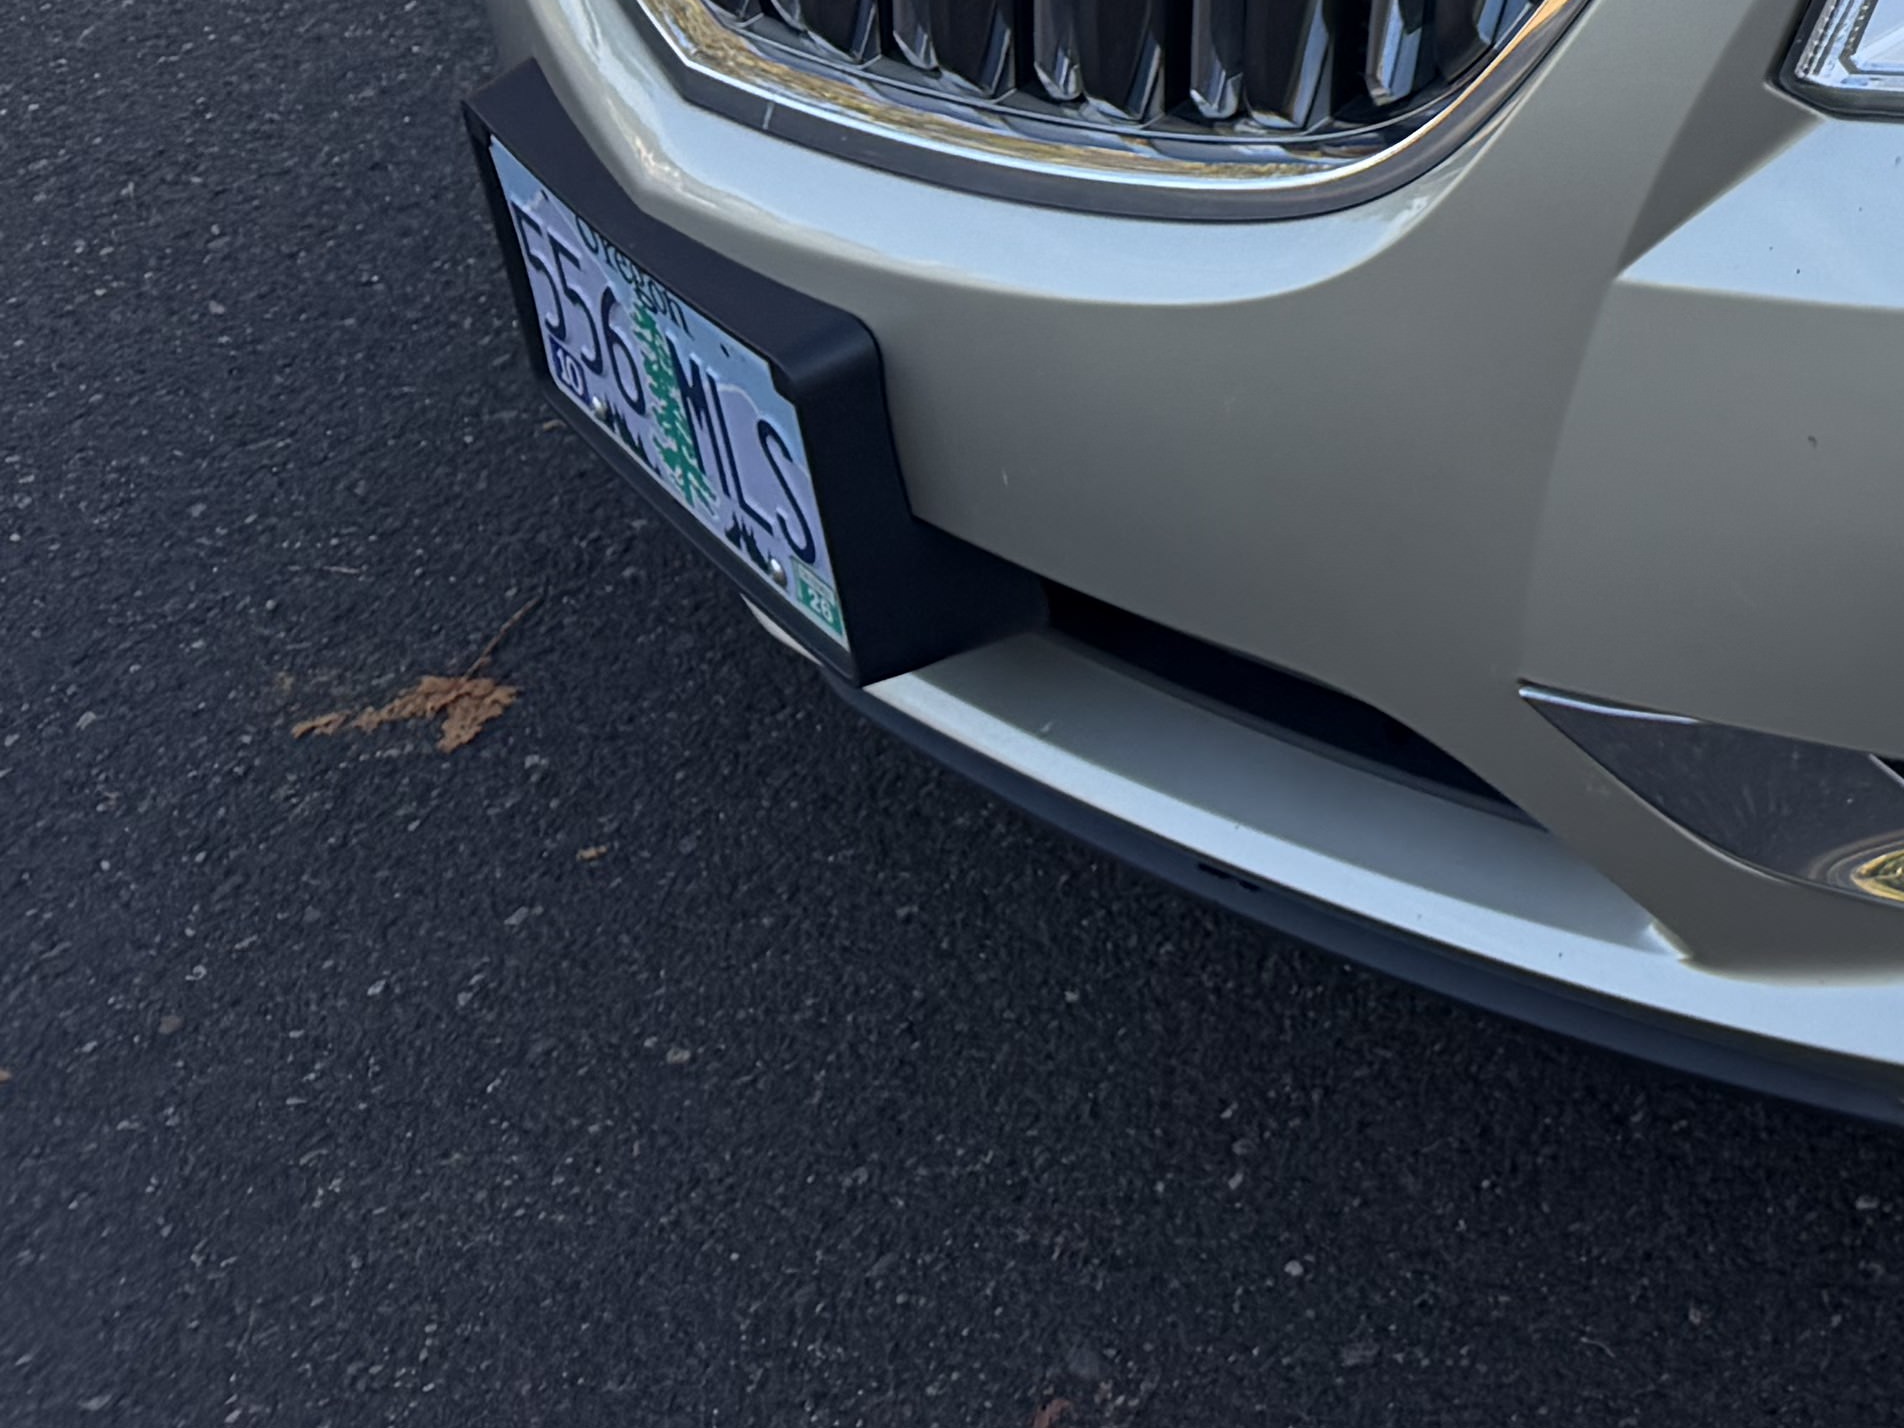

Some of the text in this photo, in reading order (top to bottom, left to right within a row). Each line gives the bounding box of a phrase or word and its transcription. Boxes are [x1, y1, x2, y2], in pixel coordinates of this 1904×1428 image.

[576, 213, 695, 341] Oregon
[510, 200, 816, 564] 556 MLS
[557, 348, 584, 396] 10
